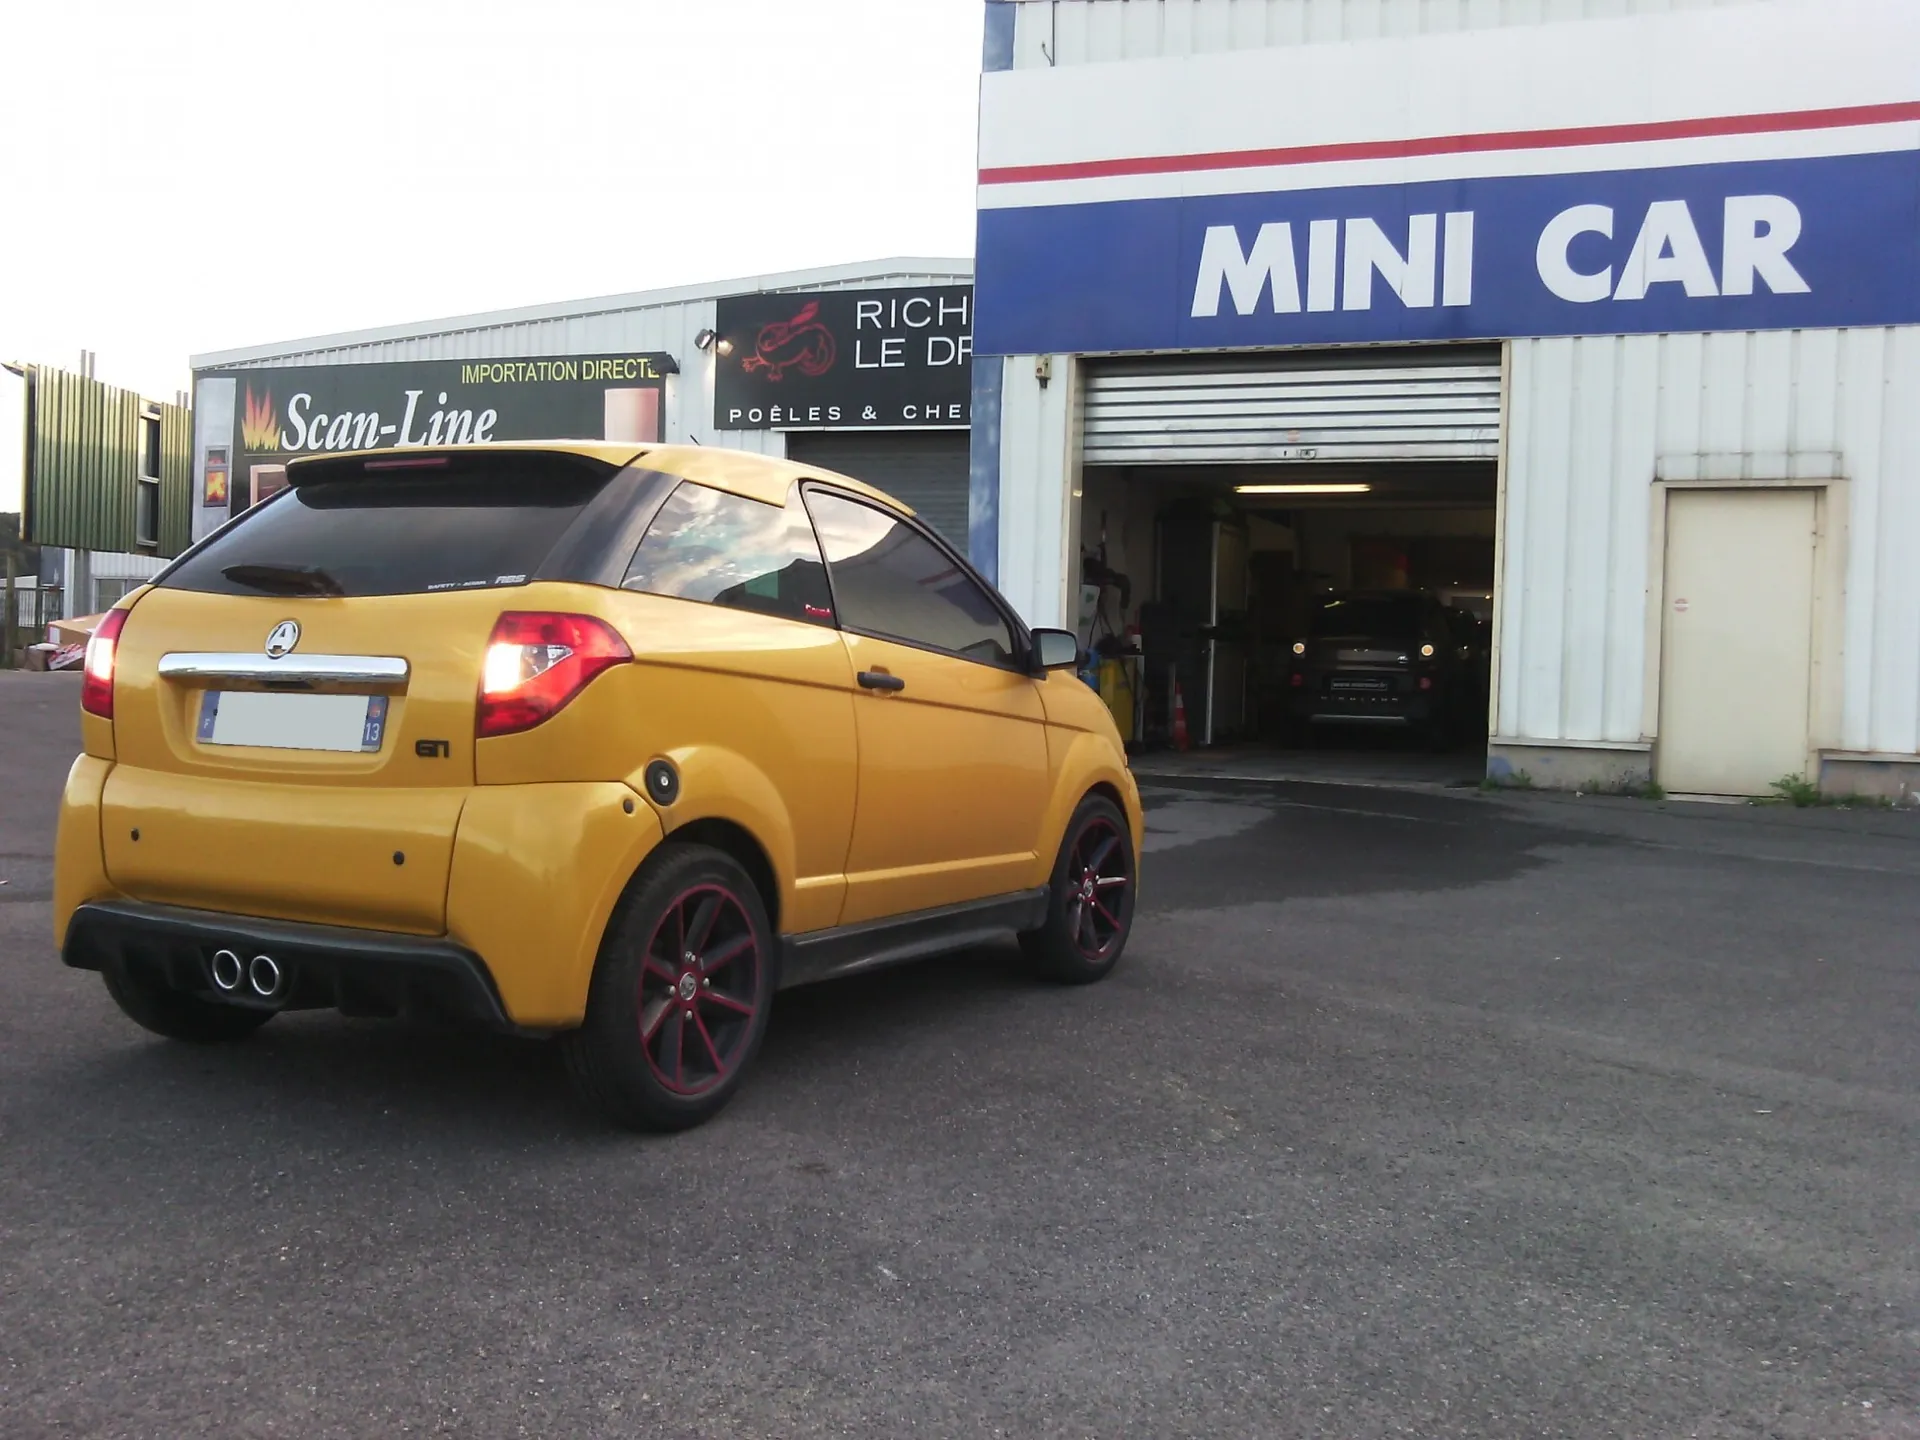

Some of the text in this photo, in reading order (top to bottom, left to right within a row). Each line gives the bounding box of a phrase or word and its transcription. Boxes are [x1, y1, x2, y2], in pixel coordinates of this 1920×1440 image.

[1191, 195, 1812, 317] MINI CAR
[855, 338, 905, 368] LE
[461, 360, 578, 384] IMPORTATION
[281, 390, 498, 451] Scan-Line
[729, 404, 972, 423] POÊLES & CHE
[364, 722, 381, 741] 13
